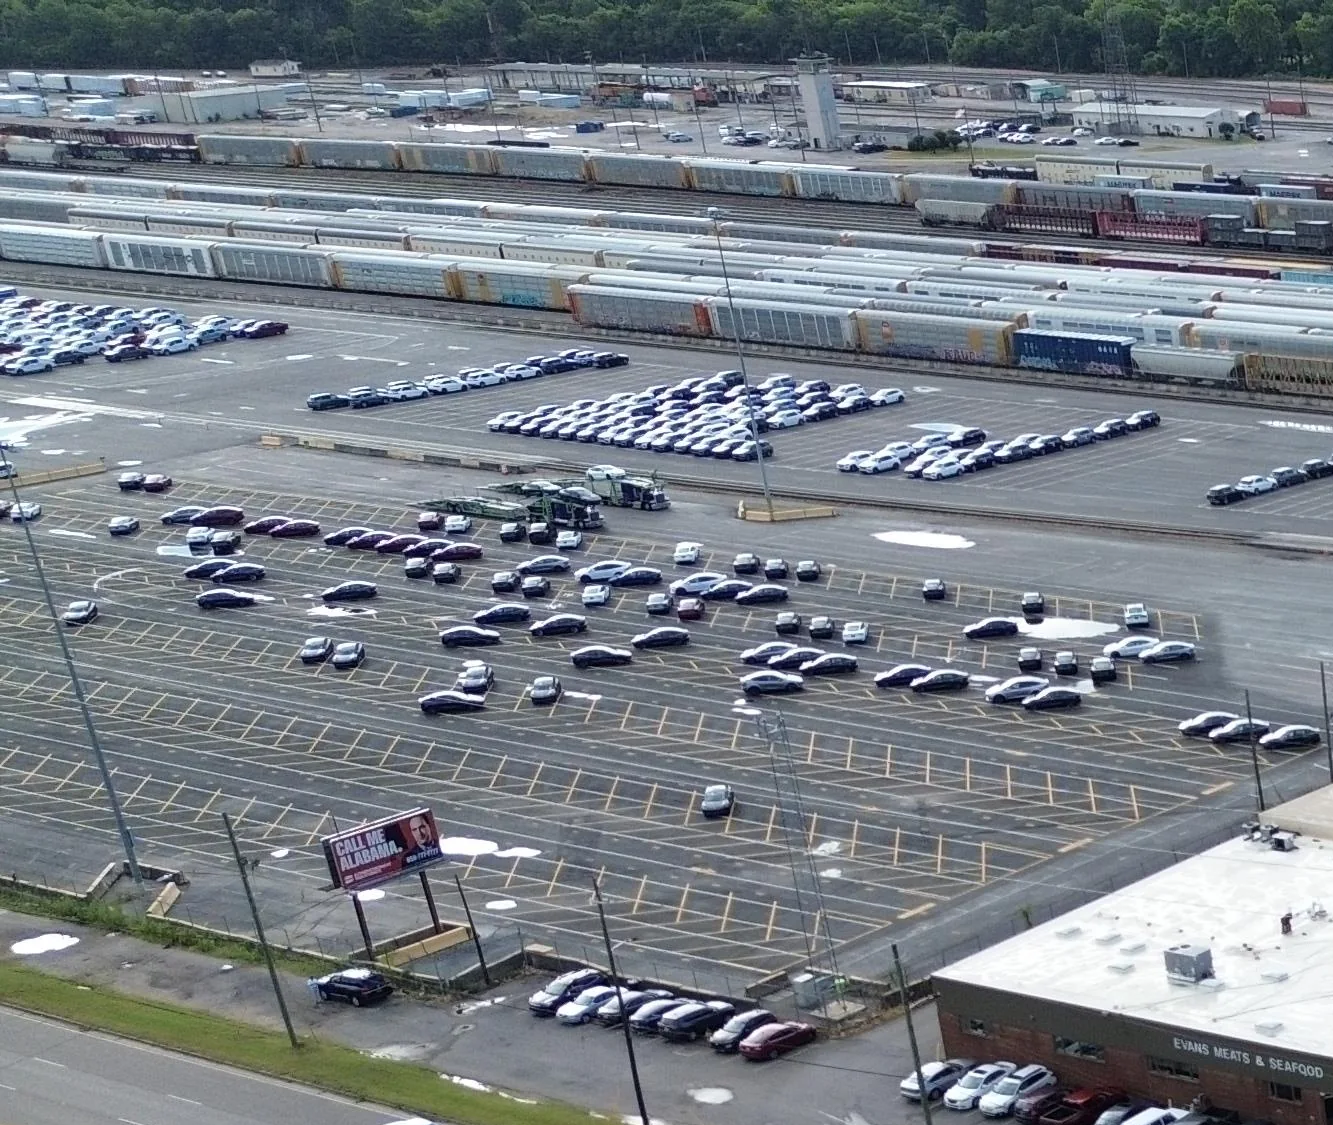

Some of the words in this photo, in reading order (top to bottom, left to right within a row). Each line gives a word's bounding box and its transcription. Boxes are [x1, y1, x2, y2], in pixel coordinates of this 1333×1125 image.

[336, 834, 364, 856] CALL
[367, 829, 386, 847] ME
[1173, 1037, 1210, 1056] EVANS
[1213, 1046, 1250, 1065] MEATS
[1255, 1055, 1265, 1067] &
[1268, 1057, 1324, 1079] SEAFOOD
